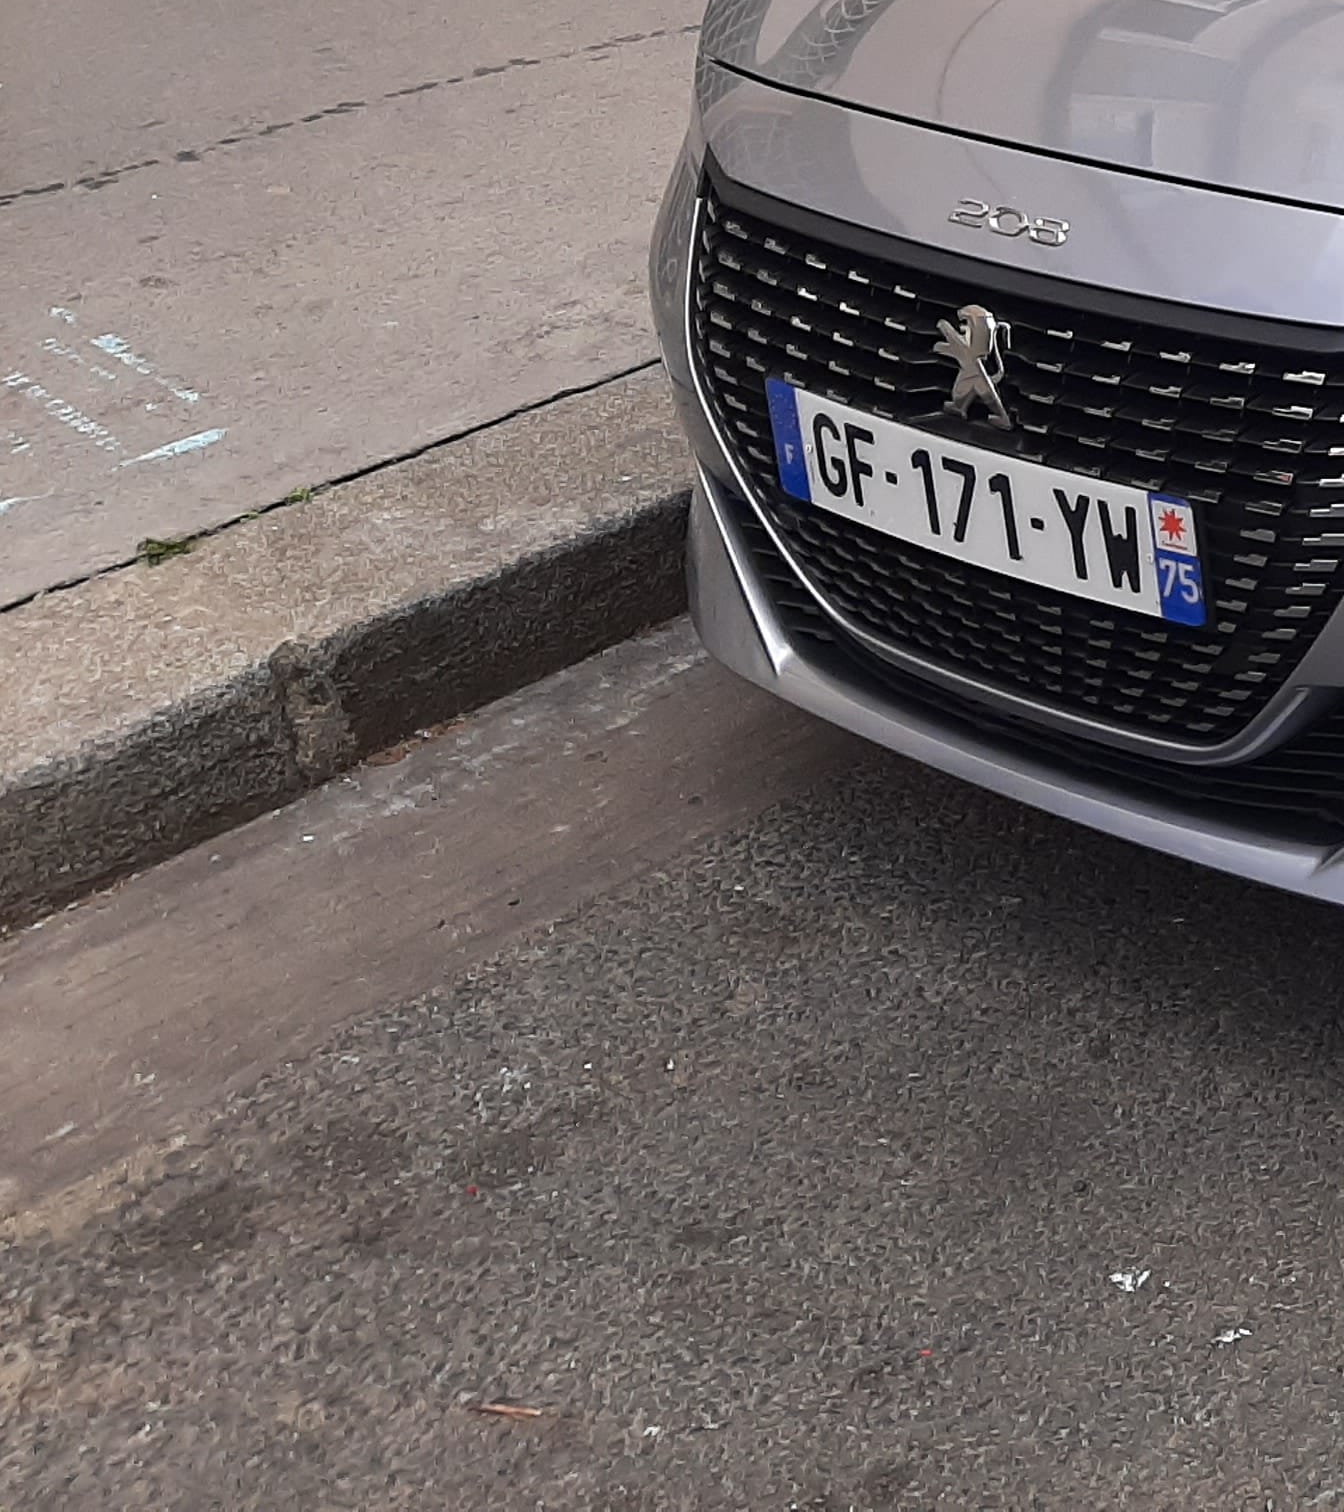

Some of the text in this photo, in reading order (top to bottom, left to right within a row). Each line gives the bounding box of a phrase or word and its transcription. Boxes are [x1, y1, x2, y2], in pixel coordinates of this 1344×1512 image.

[948, 197, 1071, 247] 208
[811, 412, 1141, 594] GF-171-YW
[1158, 557, 1200, 604] 75
